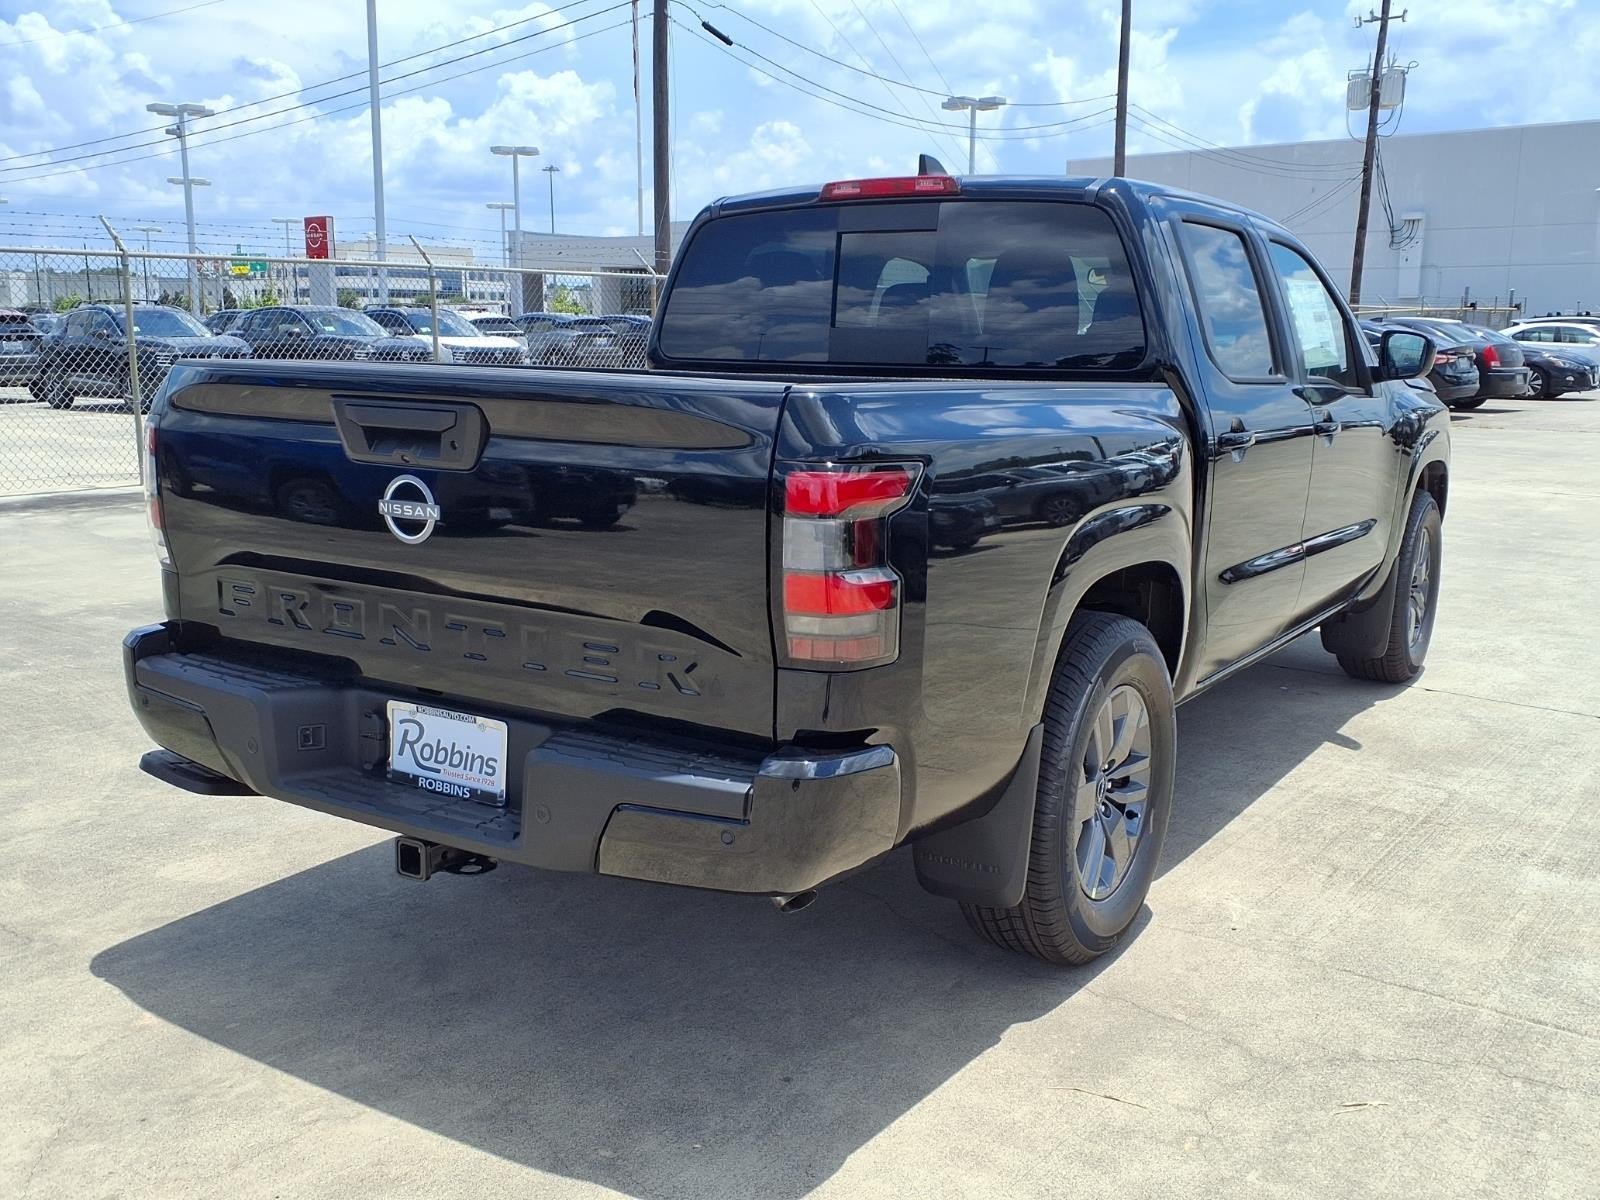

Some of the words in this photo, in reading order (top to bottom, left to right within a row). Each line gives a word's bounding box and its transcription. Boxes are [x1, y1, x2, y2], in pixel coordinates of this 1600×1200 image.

[380, 502, 438, 518] NISSAN
[217, 576, 701, 697] FRONTIER
[398, 718, 498, 777] Robbins
[443, 769, 464, 779] Trusted
[464, 774, 480, 783] Since
[418, 777, 471, 798] ROBBINS
